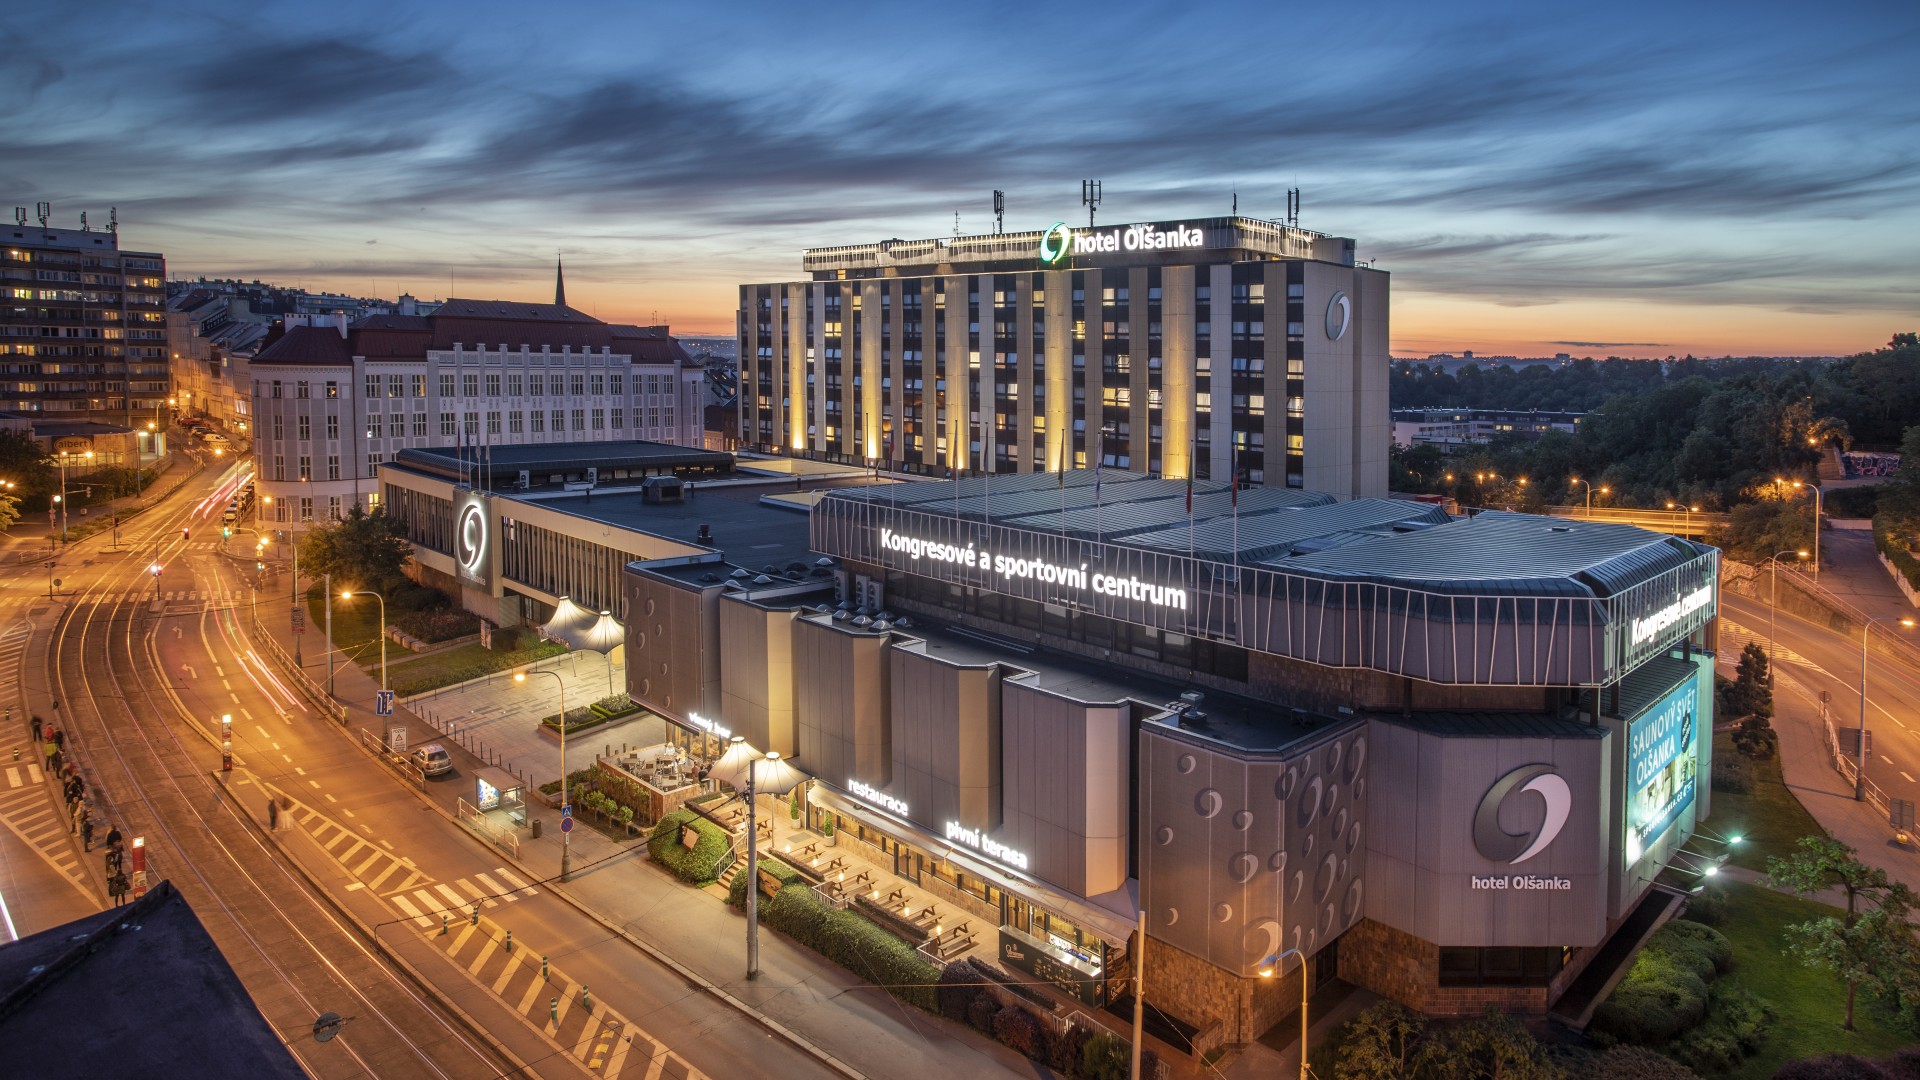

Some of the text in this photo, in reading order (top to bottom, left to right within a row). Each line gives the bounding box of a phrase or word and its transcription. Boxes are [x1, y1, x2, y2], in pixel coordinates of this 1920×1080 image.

[1075, 224, 1204, 253] hotel Olšanka
[58, 440, 88, 448] albert
[881, 528, 1187, 609] Kongresové a sportovní centrum
[1631, 593, 1681, 646] Kongresové
[1632, 702, 1676, 760] SAUNOVÝ
[1676, 688, 1695, 723] SVĚT
[1636, 736, 1676, 786] OLŠANKA
[848, 779, 909, 816] restaurace
[946, 821, 1028, 869] pivní terasa
[1471, 874, 1571, 890] hotel Olšanka
